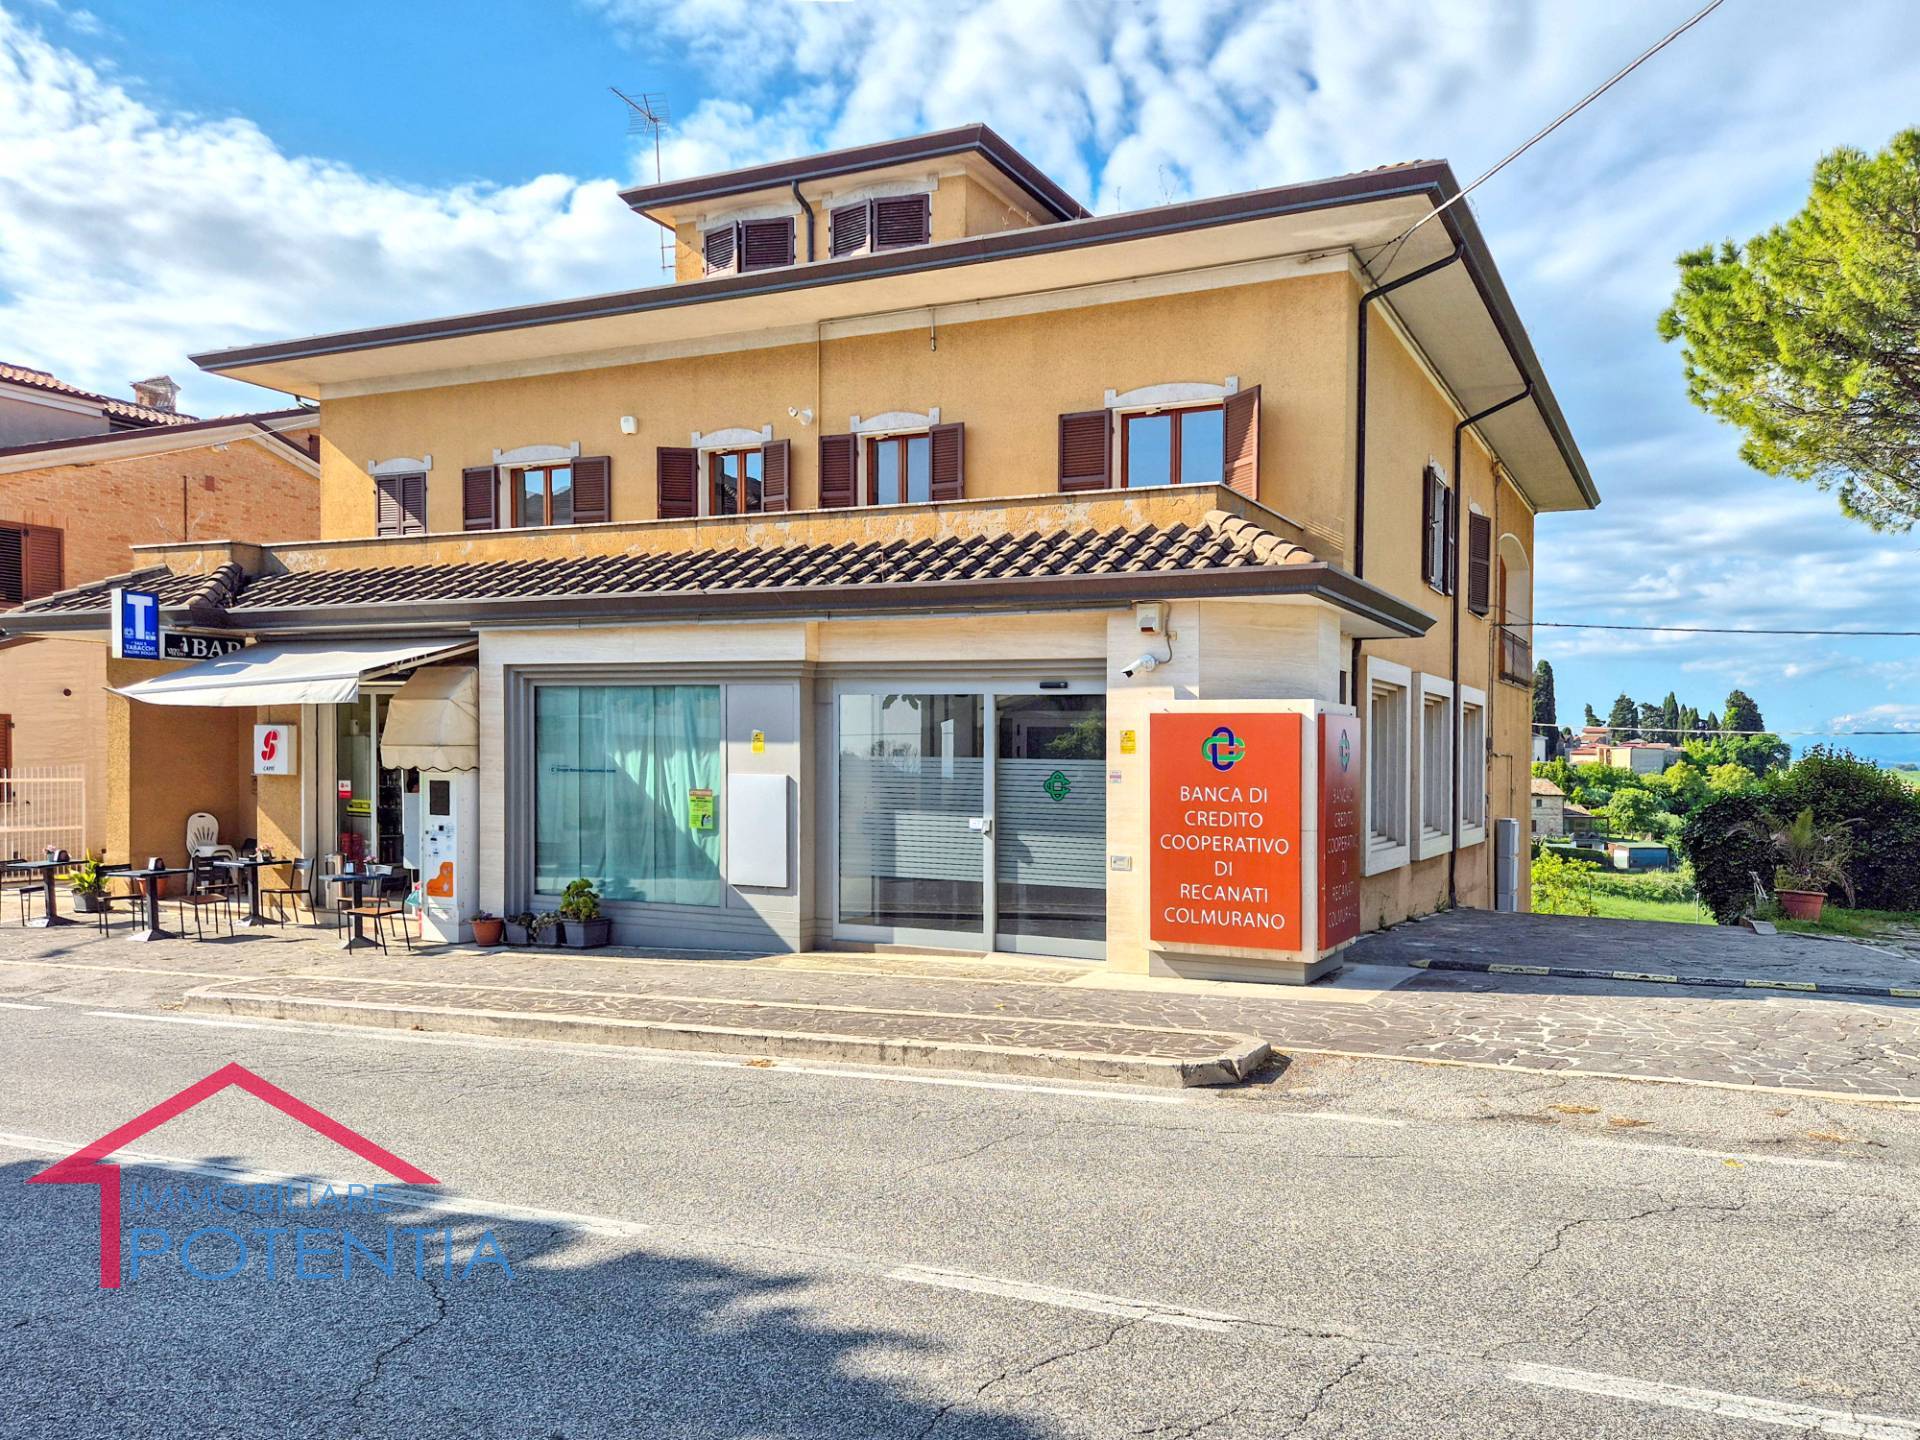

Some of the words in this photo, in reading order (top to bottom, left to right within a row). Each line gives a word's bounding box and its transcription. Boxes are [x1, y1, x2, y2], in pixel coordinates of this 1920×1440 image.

[127, 594, 153, 640] T
[125, 643, 156, 652] TABACCHI
[191, 638, 242, 658] BAR
[1180, 785, 1243, 802] BANCA
[1249, 787, 1268, 803] DI
[1184, 810, 1263, 829] CREDITO
[1160, 834, 1289, 855] COOPERATIVO
[1214, 860, 1233, 876] DI
[1180, 883, 1268, 903] RECANATI
[1164, 907, 1285, 930] COLMURANO
